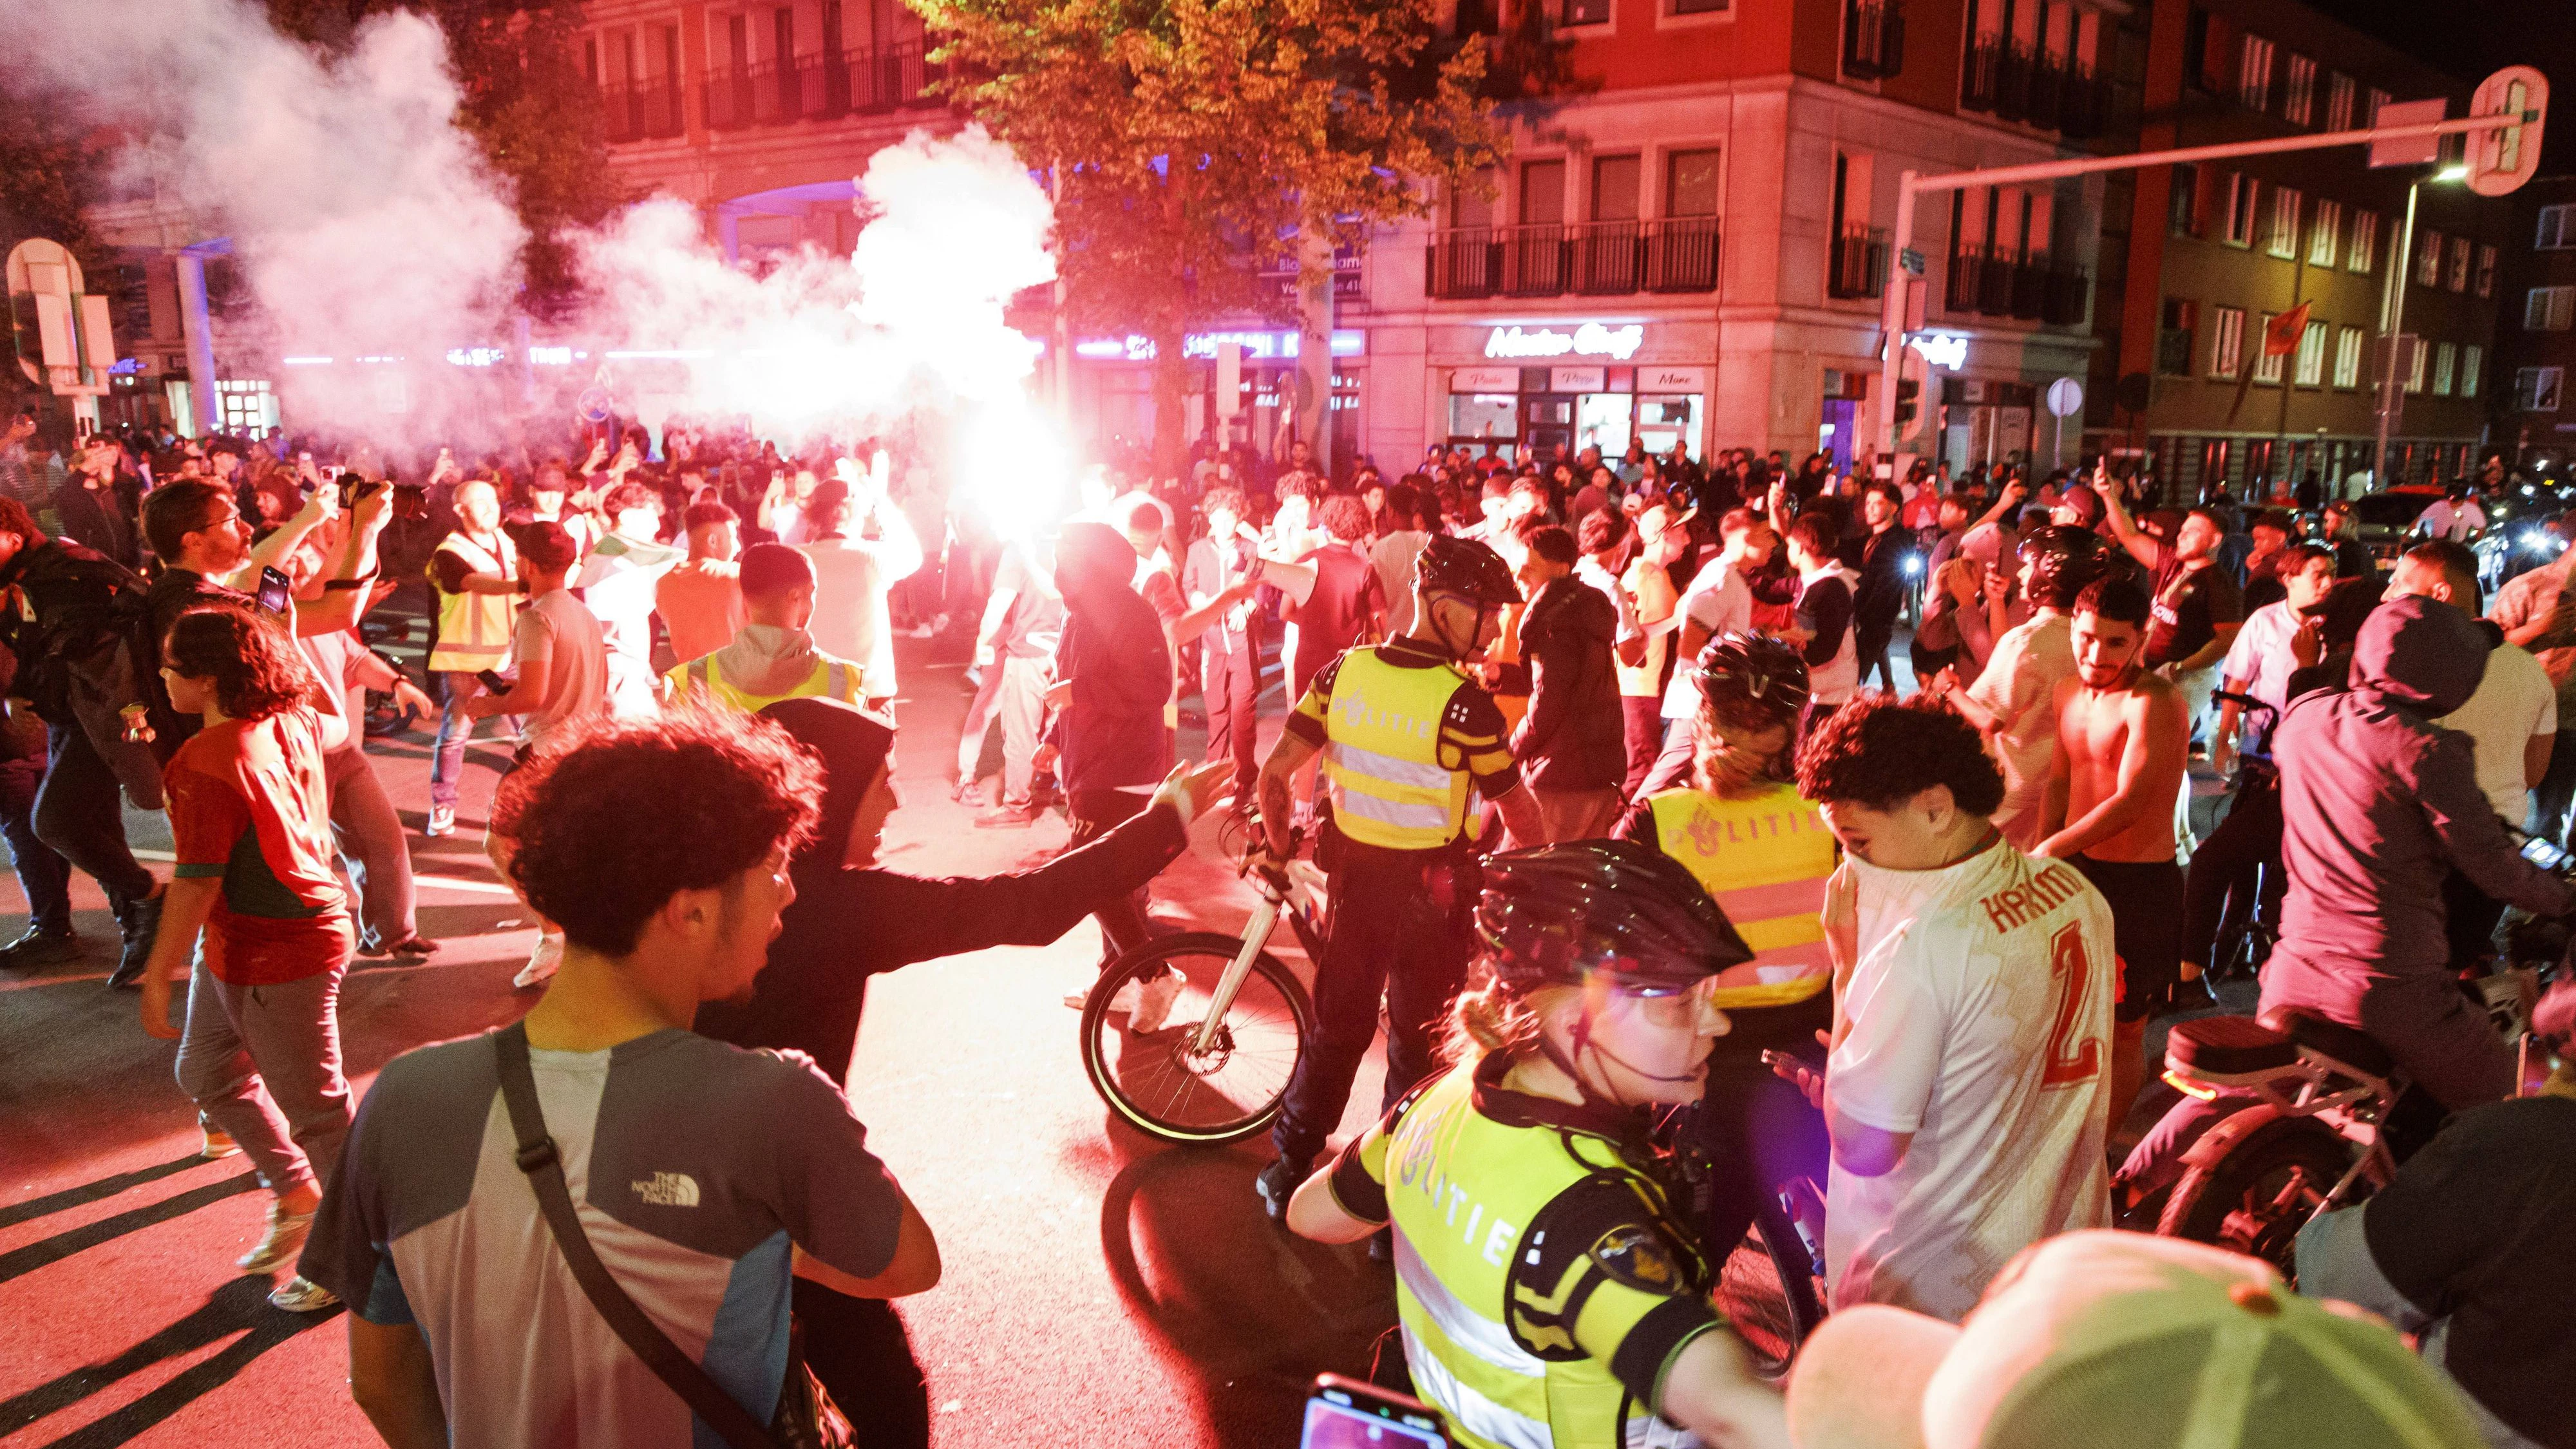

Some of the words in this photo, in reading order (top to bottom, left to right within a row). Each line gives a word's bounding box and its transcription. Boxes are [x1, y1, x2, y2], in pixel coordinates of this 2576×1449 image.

[1659, 374, 1691, 385] More
[2040, 919, 2103, 1092] 2
[654, 1171, 679, 1185] THE
[632, 1180, 678, 1195] NORTH
[643, 1192, 678, 1206] FACE
